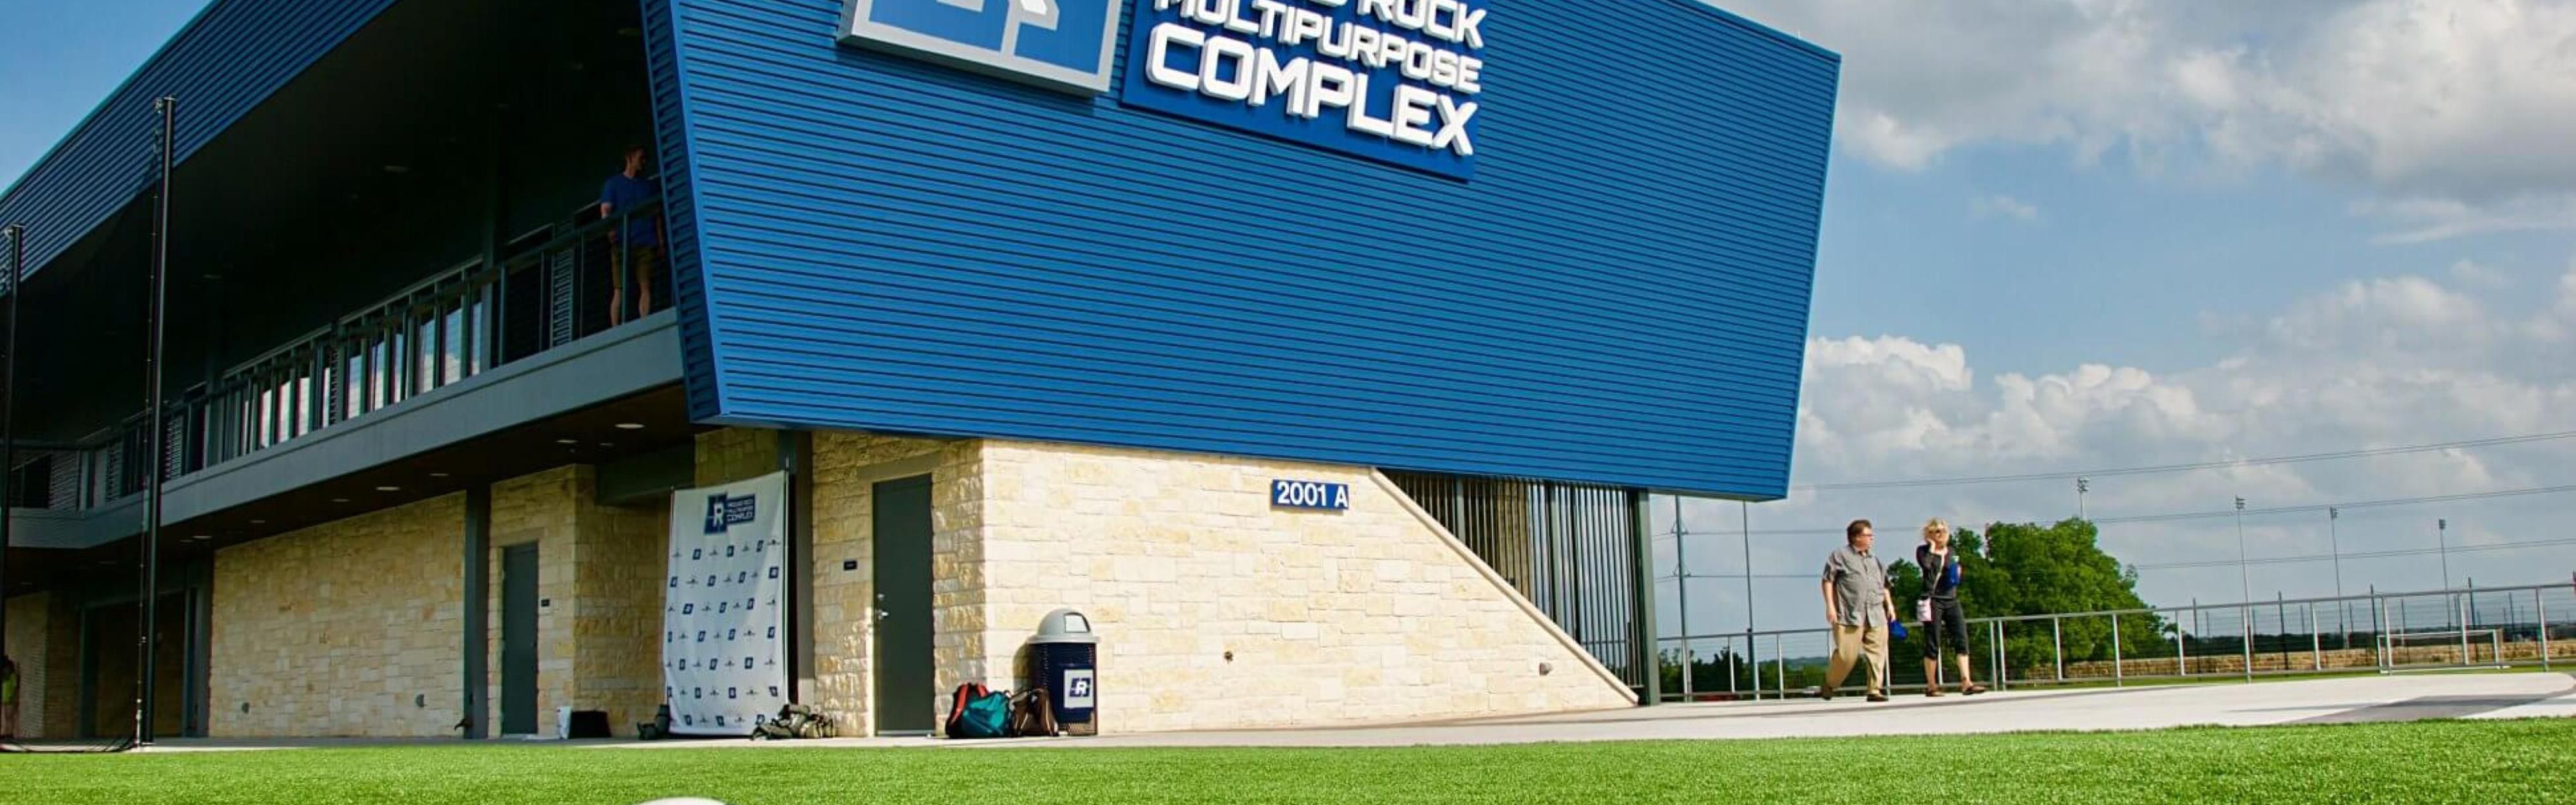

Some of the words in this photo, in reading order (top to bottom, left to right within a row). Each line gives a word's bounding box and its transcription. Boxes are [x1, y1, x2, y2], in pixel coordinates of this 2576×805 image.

[1146, 22, 1477, 156] COMPLEX
[1277, 481, 1327, 506] 2001
[1334, 486, 1348, 507] A
